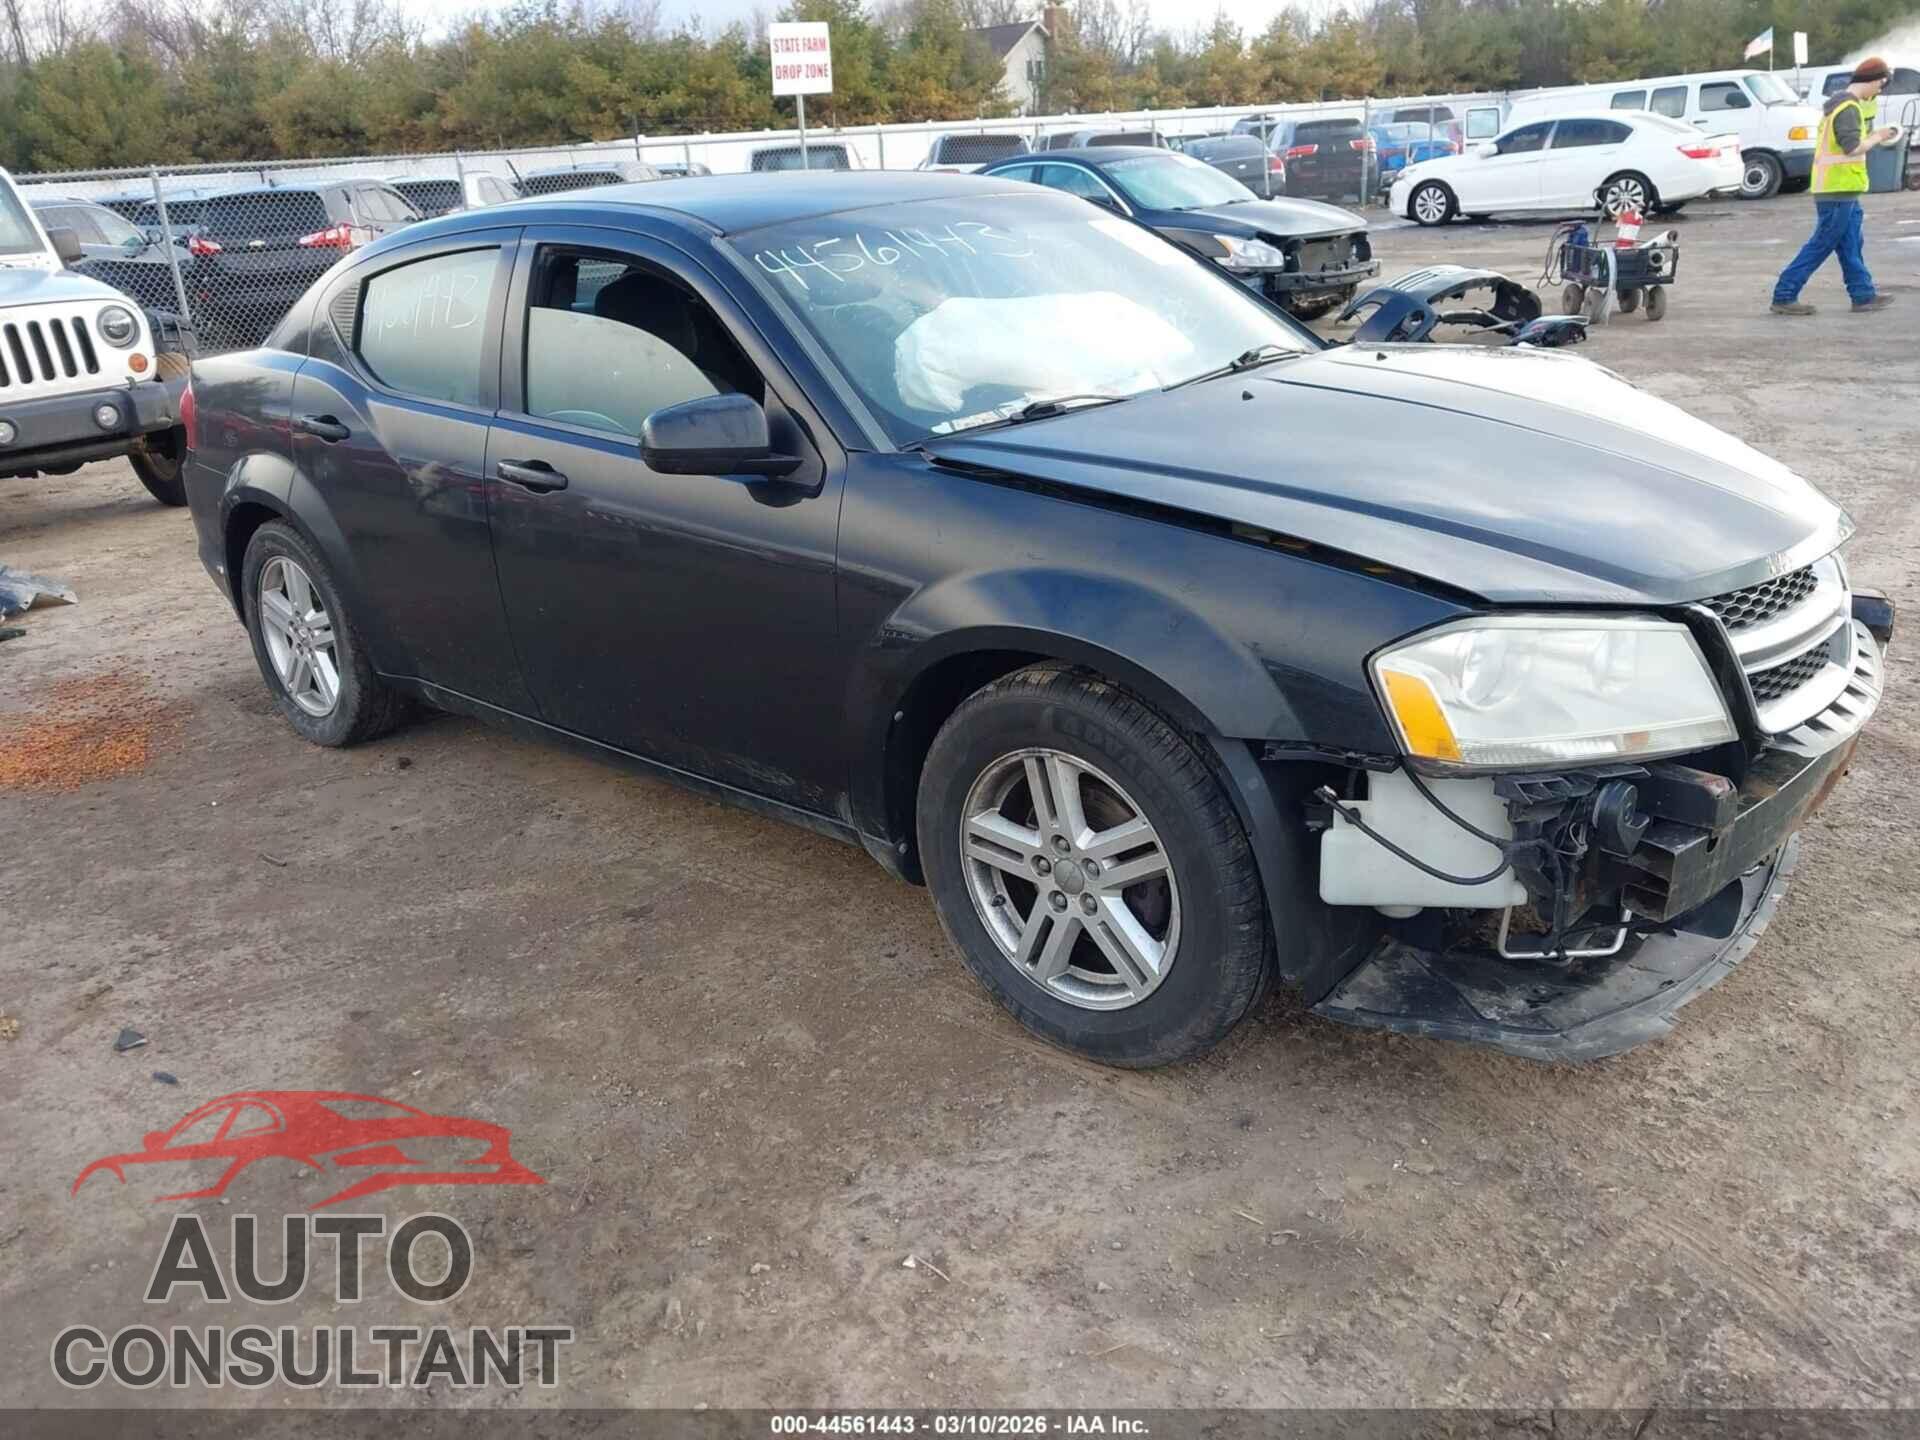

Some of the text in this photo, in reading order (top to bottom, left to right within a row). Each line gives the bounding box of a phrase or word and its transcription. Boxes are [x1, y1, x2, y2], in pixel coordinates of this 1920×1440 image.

[773, 36, 827, 53] STATE FARM
[775, 63, 829, 80] DROP ZONE
[754, 222, 1034, 290] 44561443
